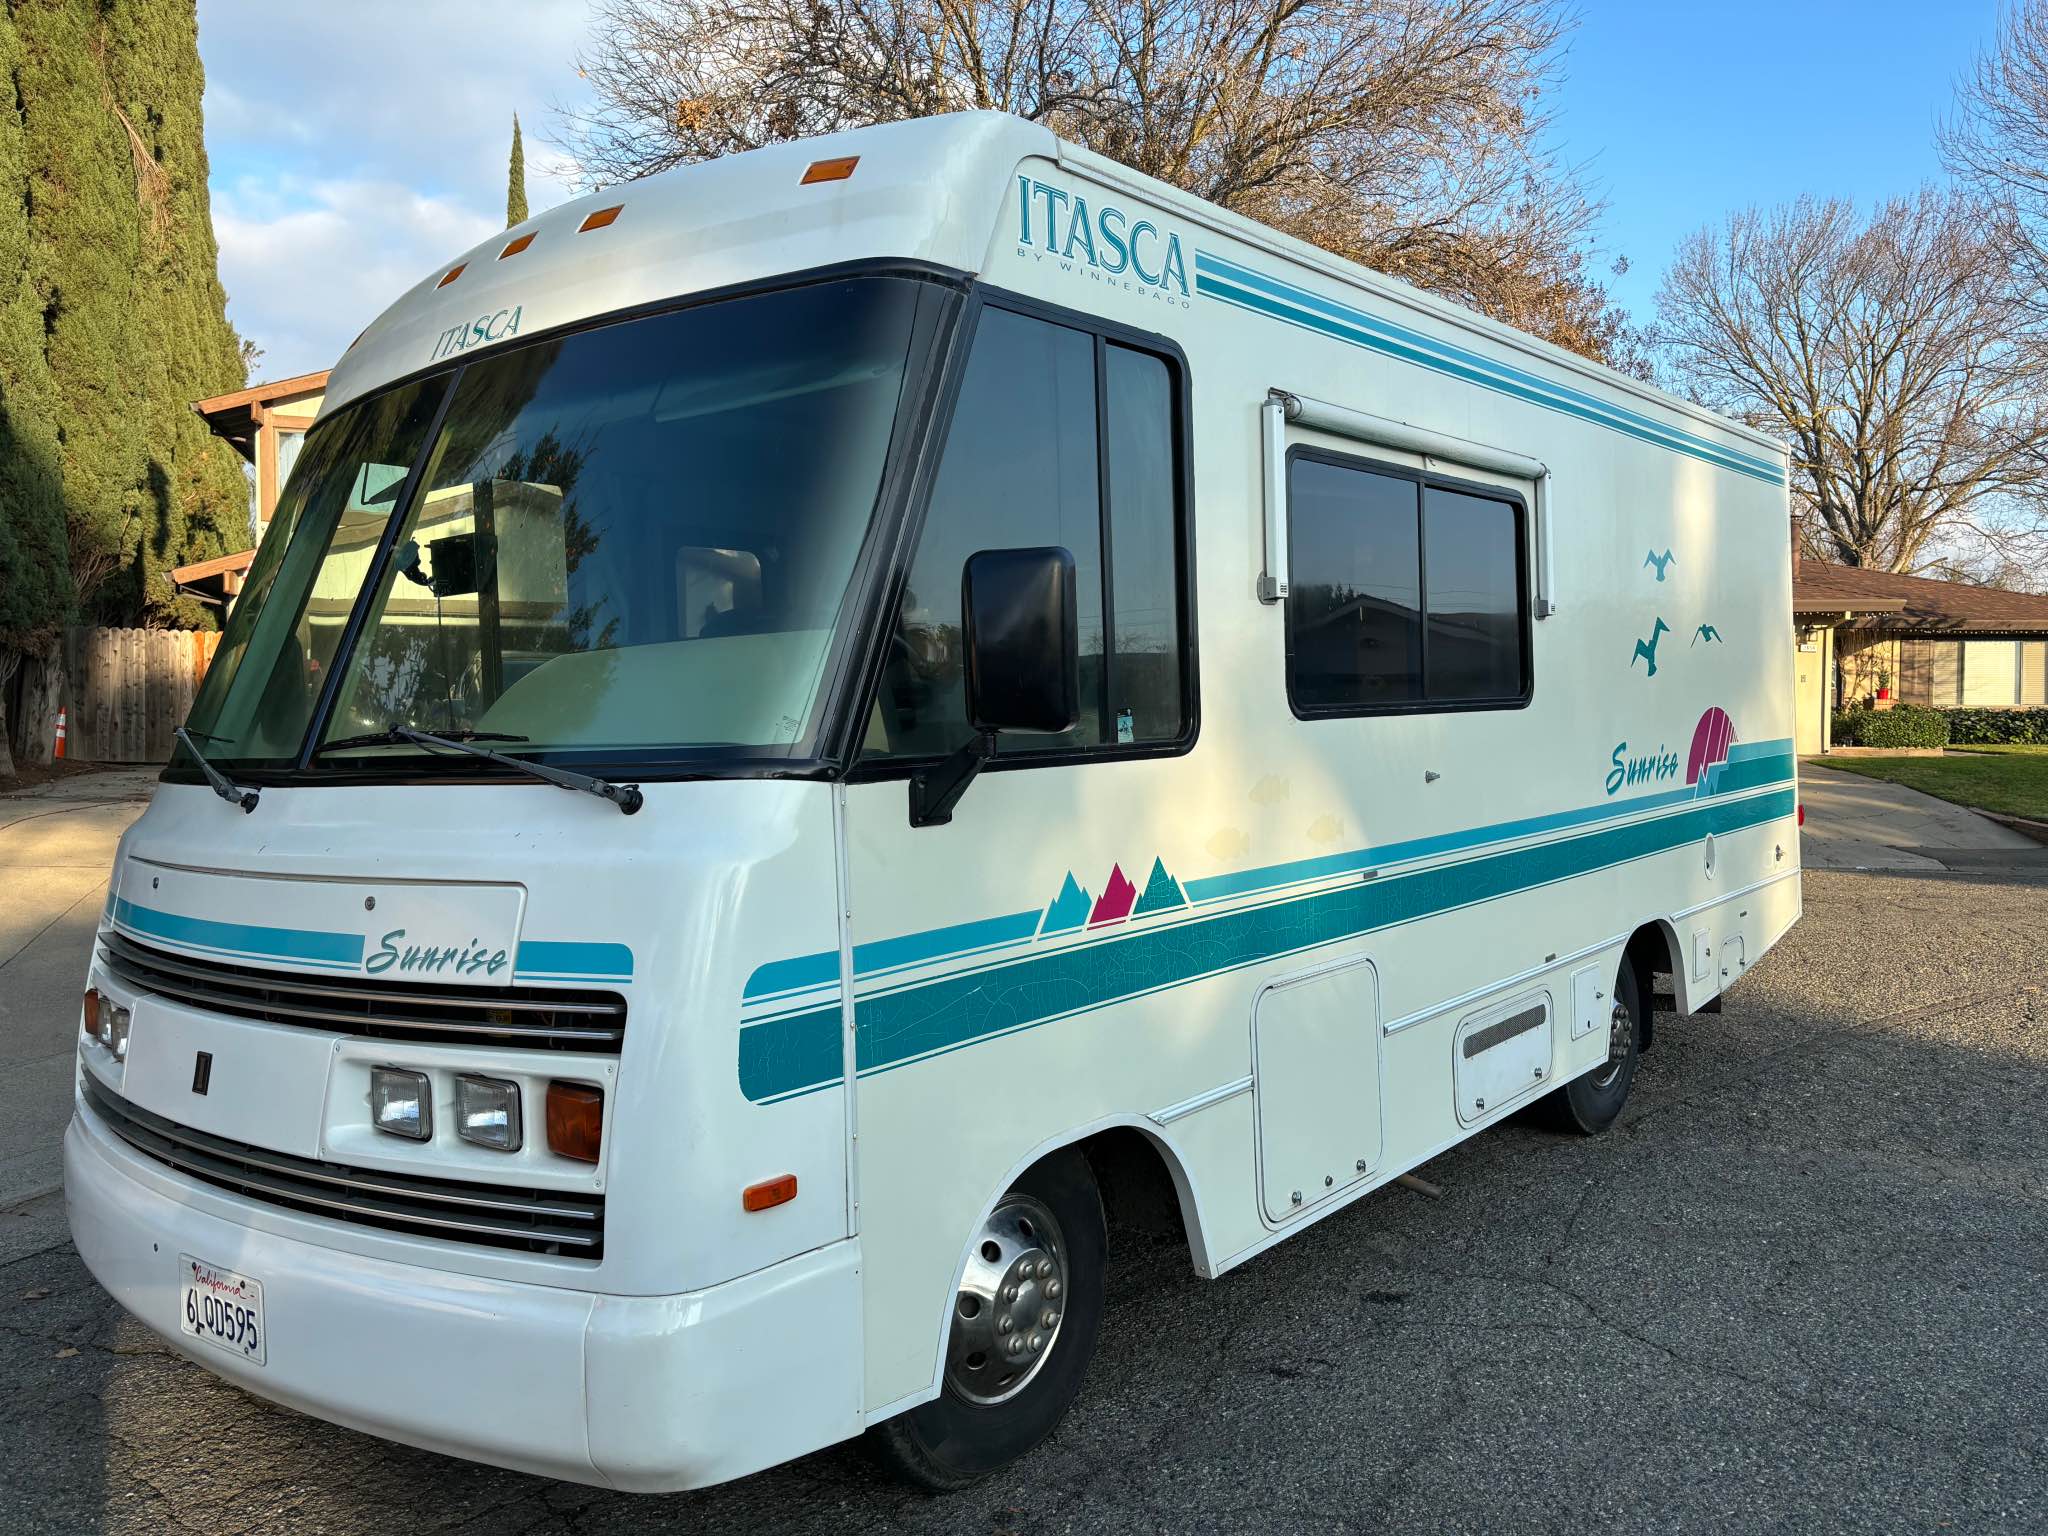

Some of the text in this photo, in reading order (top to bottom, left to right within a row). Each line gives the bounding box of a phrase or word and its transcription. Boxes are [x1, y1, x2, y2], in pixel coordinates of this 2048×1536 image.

[1018, 175, 1190, 297] ITASCA
[1016, 247, 1190, 309] BY WINNEBAGO
[429, 305, 522, 361] ITASCA
[1605, 741, 1679, 796] Sunrise
[365, 928, 508, 976] Sunrise
[194, 1264, 246, 1299] California
[187, 1288, 257, 1350] 6LQD595
